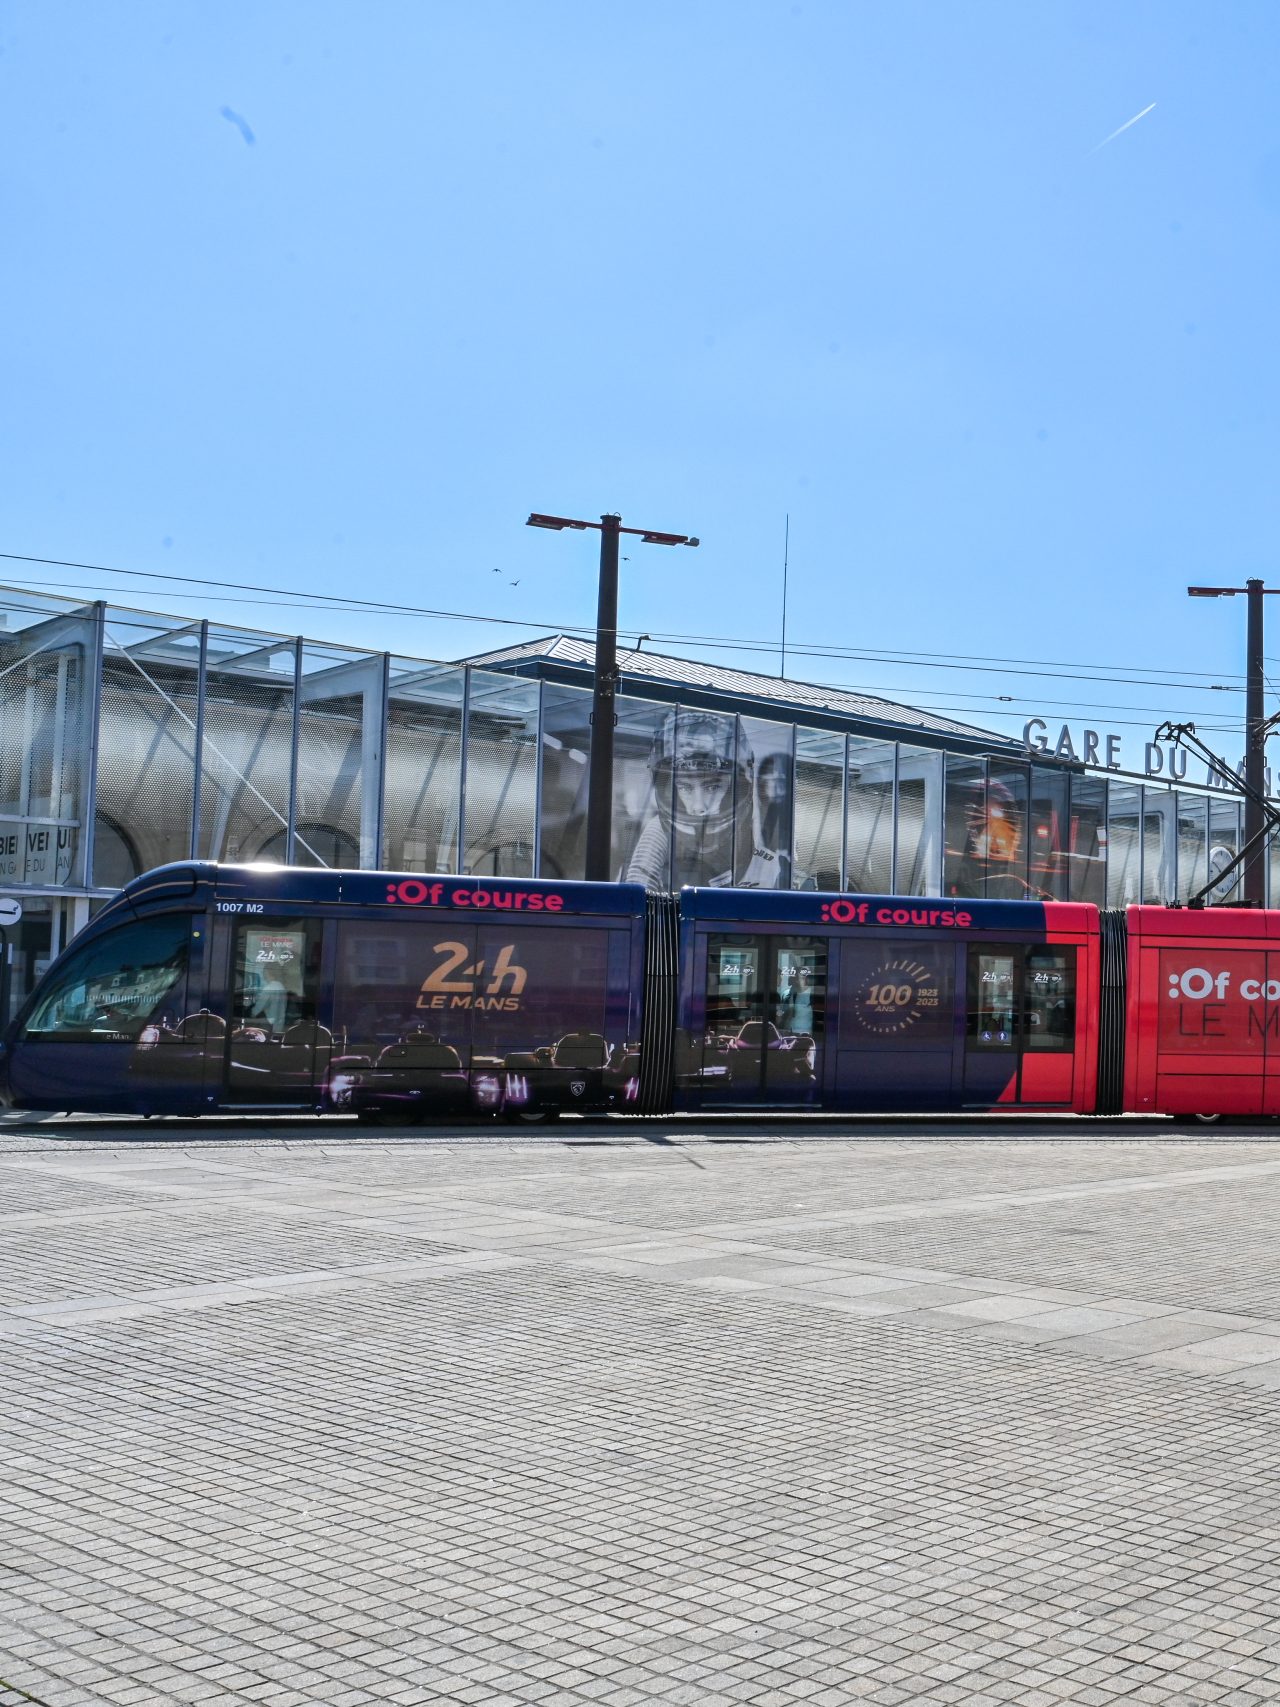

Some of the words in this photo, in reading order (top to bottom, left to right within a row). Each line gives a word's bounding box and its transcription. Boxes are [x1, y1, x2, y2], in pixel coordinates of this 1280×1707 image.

[1022, 718, 1121, 768] GARE
[1144, 742, 1187, 780] DU
[216, 902, 244, 912] 1007
[246, 903, 264, 913] M2
[451, 889, 564, 911] course
[876, 907, 973, 927] course
[865, 984, 912, 1006] 100
[915, 998, 939, 1006] 2023
[917, 988, 939, 997] 1923
[415, 995, 448, 1009] LE
[450, 995, 521, 1011] MANS
[1178, 1002, 1227, 1037] LE
